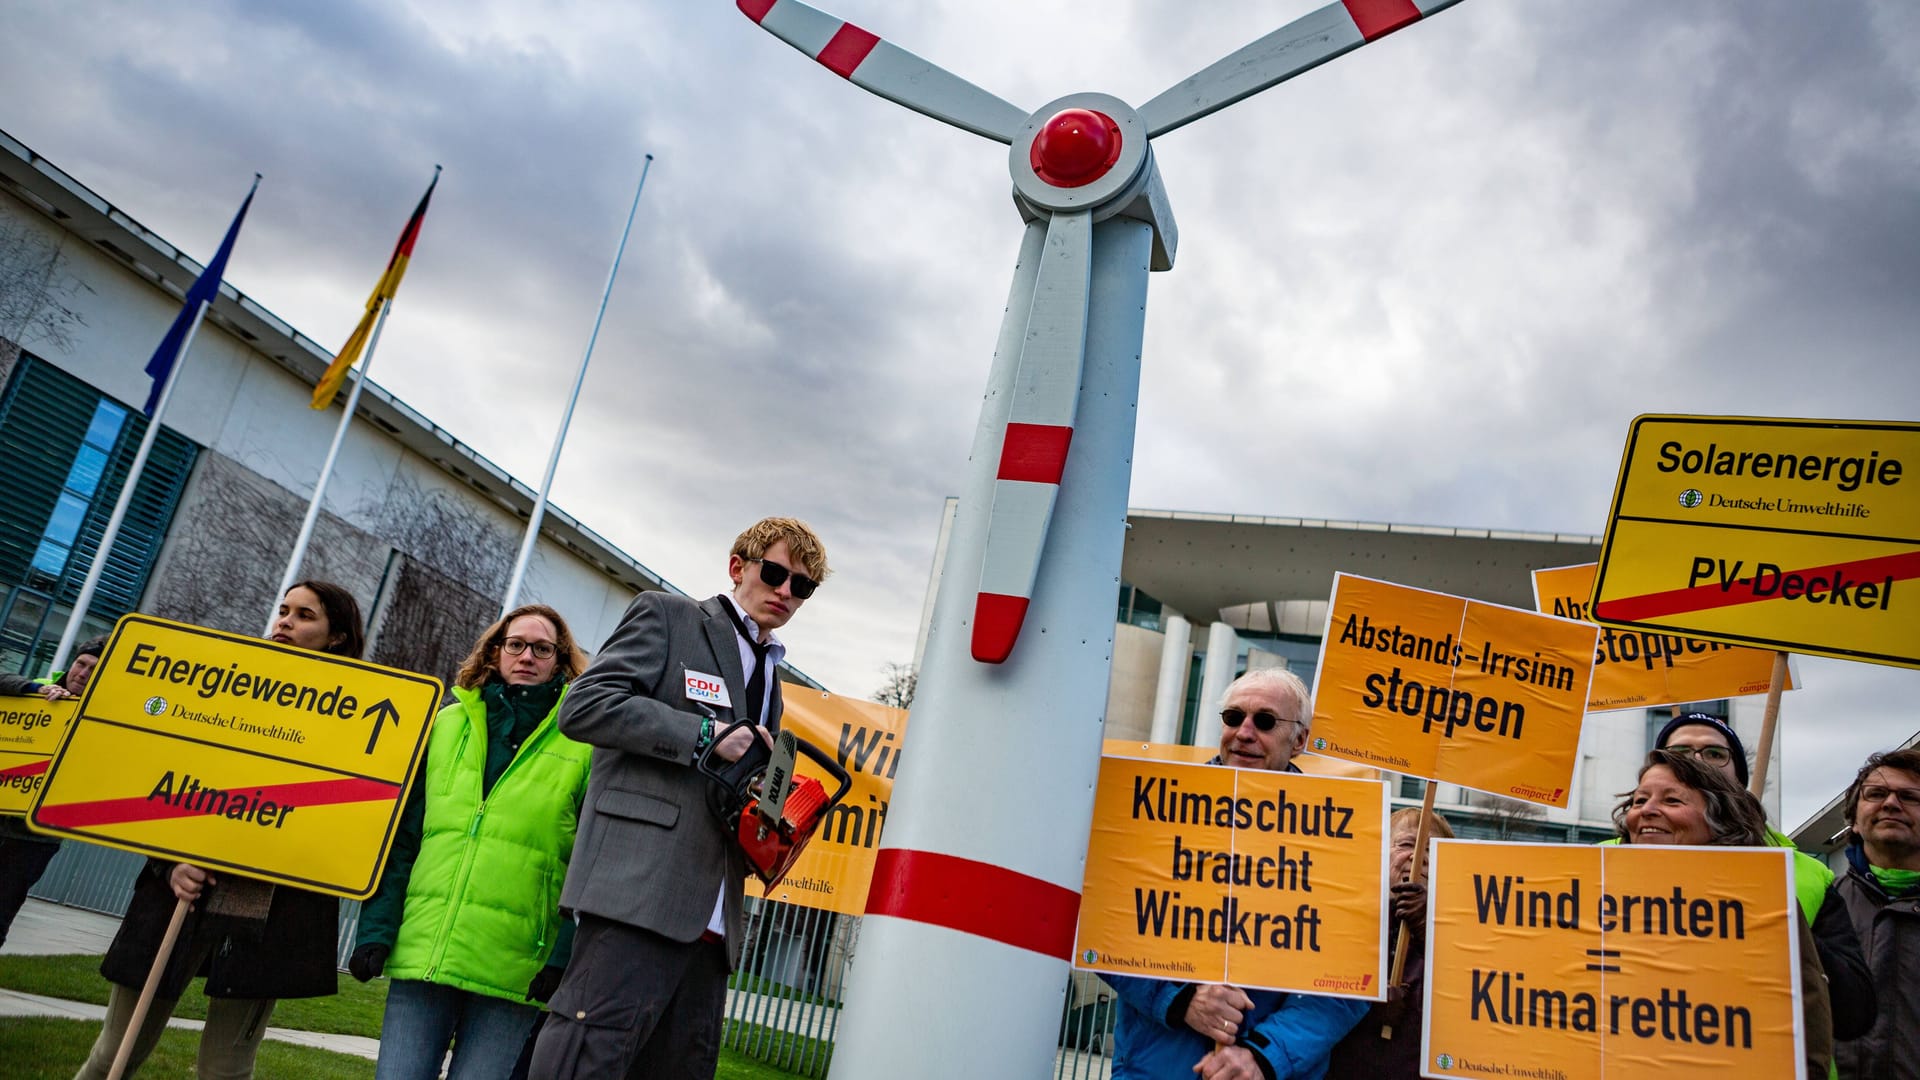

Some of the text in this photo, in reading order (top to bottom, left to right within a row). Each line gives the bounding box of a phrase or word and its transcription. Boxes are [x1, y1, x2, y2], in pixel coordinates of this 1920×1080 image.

[1657, 441, 1903, 492] Solarenergie
[1709, 493, 1870, 518] Deutsche Umwelthilfe
[1688, 556, 1894, 611] PV-Deckel
[1340, 613, 1574, 691] Abstands-Irrsinn
[126, 643, 358, 720] Energiewende
[687, 678, 720, 693] CDU
[1362, 667, 1525, 740] stoppen
[171, 703, 306, 744] Deutsche Umwelthilfe
[1330, 742, 1411, 768] Deutsche Umwelthilfe
[147, 770, 294, 830] Altmaier
[768, 766, 785, 805] DOLMAR
[1132, 775, 1354, 839] Klimaschutz
[1172, 836, 1313, 893] braucht
[1135, 888, 1322, 953] Windkraft
[1474, 874, 1746, 940] Wind ernten
[1102, 953, 1196, 973] Deutsche Umwelthilfe
[1471, 970, 1753, 1050] Klima retten
[1459, 1058, 1568, 1080] Deutsche Umwelthilfe
